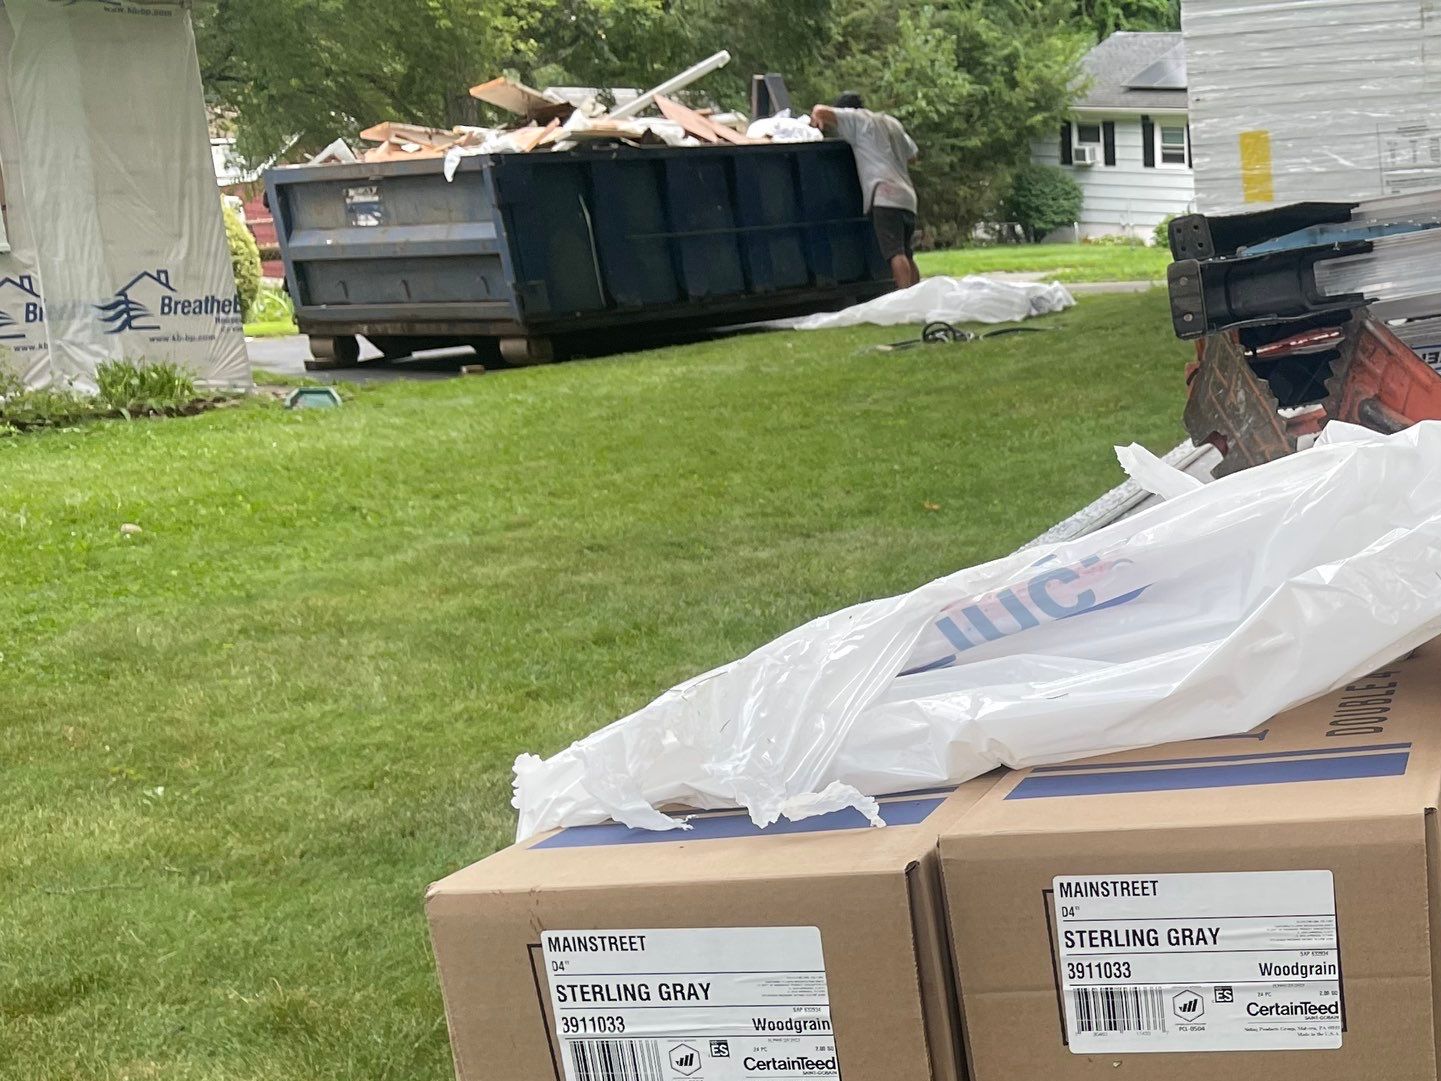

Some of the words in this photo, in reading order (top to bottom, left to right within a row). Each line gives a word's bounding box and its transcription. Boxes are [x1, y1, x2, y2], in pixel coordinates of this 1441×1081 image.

[1325, 682, 1398, 737] DOUBLE
[1060, 881, 1158, 897] MAINSTREET
[1062, 906, 1080, 918] D4"
[548, 936, 645, 952] MAINSTREET
[1064, 929, 1159, 948] STERLING
[1168, 928, 1220, 946] GRAY
[552, 961, 570, 971] D4"
[1068, 962, 1131, 979] 3911033
[1259, 962, 1336, 977] Woodgrain
[556, 984, 651, 1002] STERLING
[659, 983, 710, 1001] GRAY
[1216, 990, 1232, 1002] ES
[1247, 1001, 1339, 1019] CertainTeed
[562, 1016, 625, 1033] 3911033
[752, 1018, 830, 1033] Woodgrain
[711, 1044, 728, 1056] ES
[744, 1057, 836, 1070] CertainTeed
